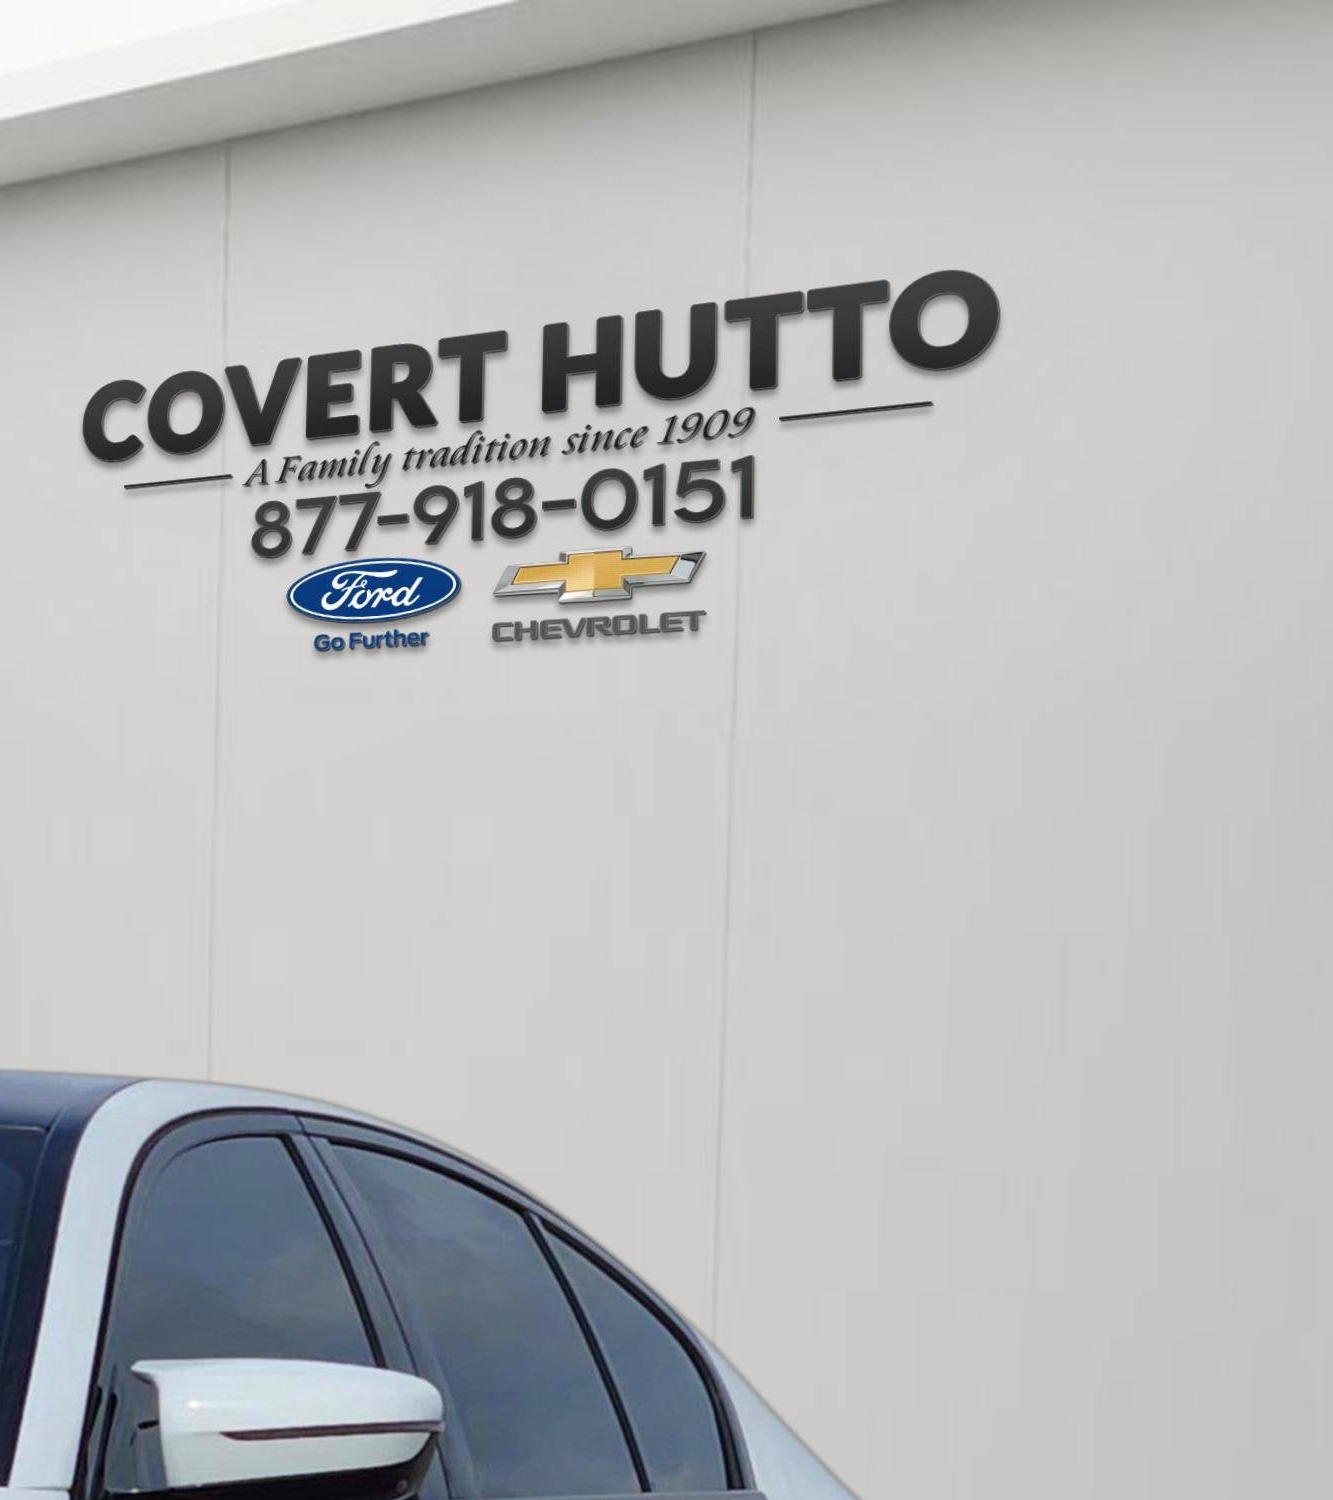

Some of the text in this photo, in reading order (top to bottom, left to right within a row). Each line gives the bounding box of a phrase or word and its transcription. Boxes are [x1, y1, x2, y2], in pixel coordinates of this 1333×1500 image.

[82, 269, 1001, 465] COVERT HUTTO
[242, 406, 756, 490] A Family tradition since 1909
[250, 454, 756, 560] 877-918-0151
[321, 569, 424, 610] Ford
[313, 628, 430, 653] Go Further
[491, 610, 707, 643] CHEVROLET
